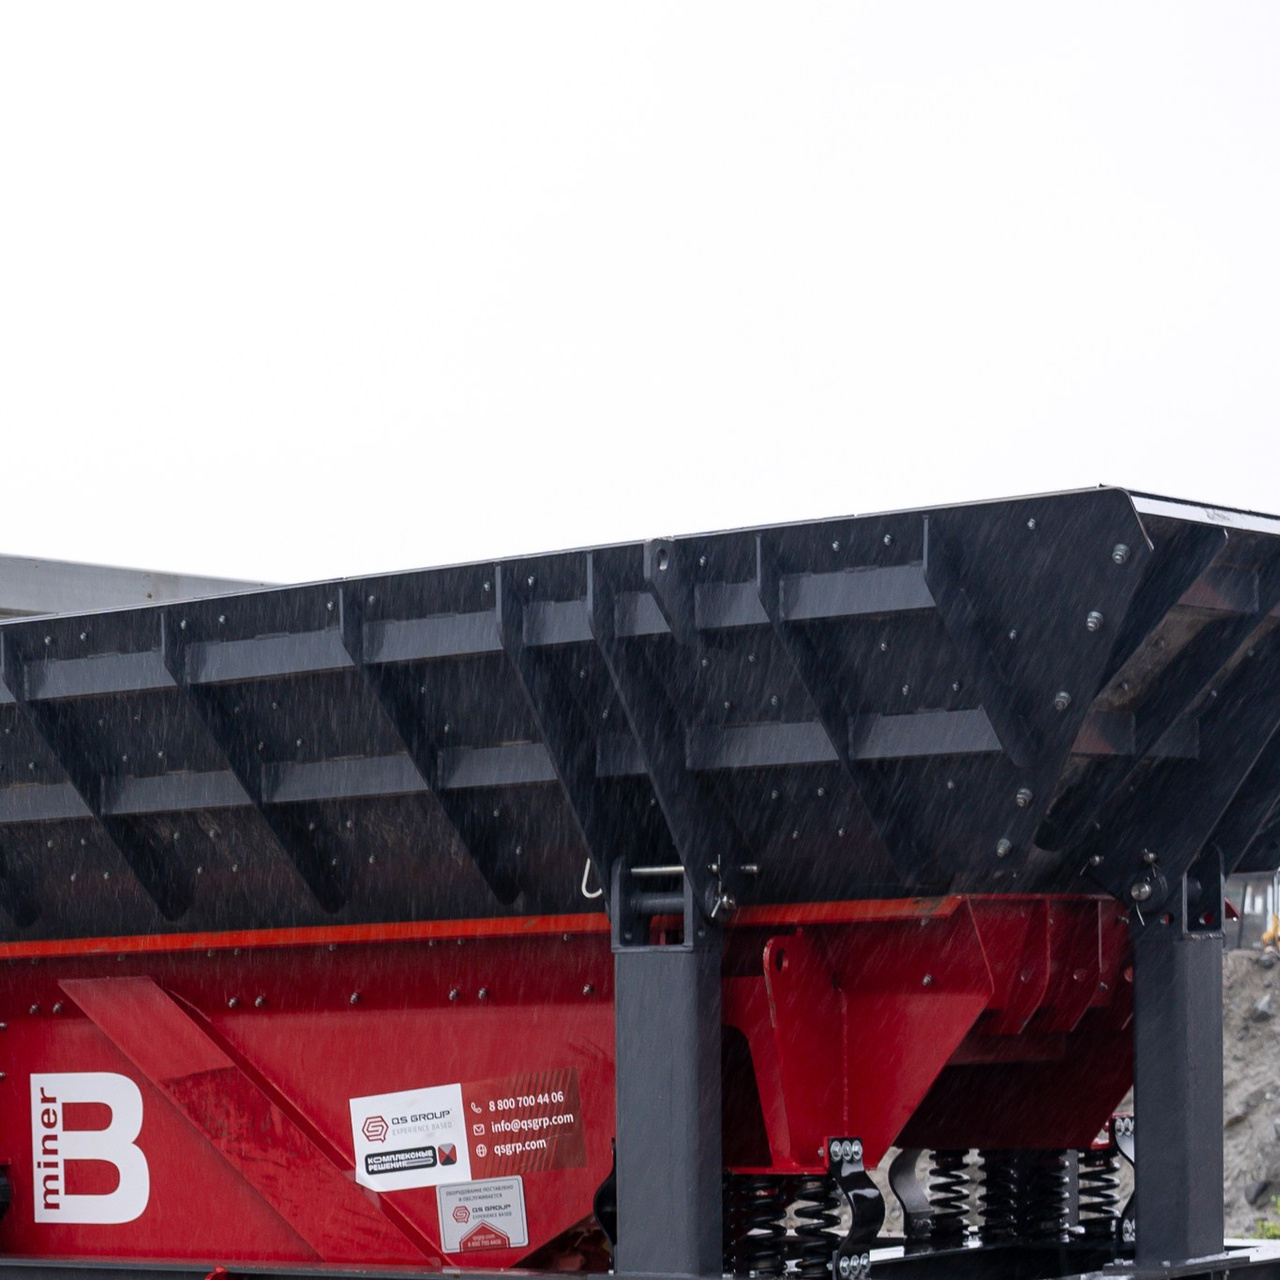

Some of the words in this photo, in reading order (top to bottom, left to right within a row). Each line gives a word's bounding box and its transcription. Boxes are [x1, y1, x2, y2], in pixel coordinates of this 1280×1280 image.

[489, 1100, 495, 1112] 8
[497, 1098, 515, 1110] 800
[517, 1095, 535, 1107] 700
[537, 1093, 549, 1105] 44
[551, 1091, 564, 1103] 06
[391, 1116, 408, 1125] QS
[410, 1110, 450, 1123] GROUP
[491, 1113, 574, 1133] info@qsgrp.com
[392, 1124, 429, 1136] EXPERIENCE
[431, 1121, 452, 1131] BASED
[30, 1072, 150, 1224] B
[36, 1087, 60, 1210] miner
[368, 1149, 433, 1164] КОМПЛЕКСНЫЕ
[494, 1139, 547, 1156] qsgrp.com
